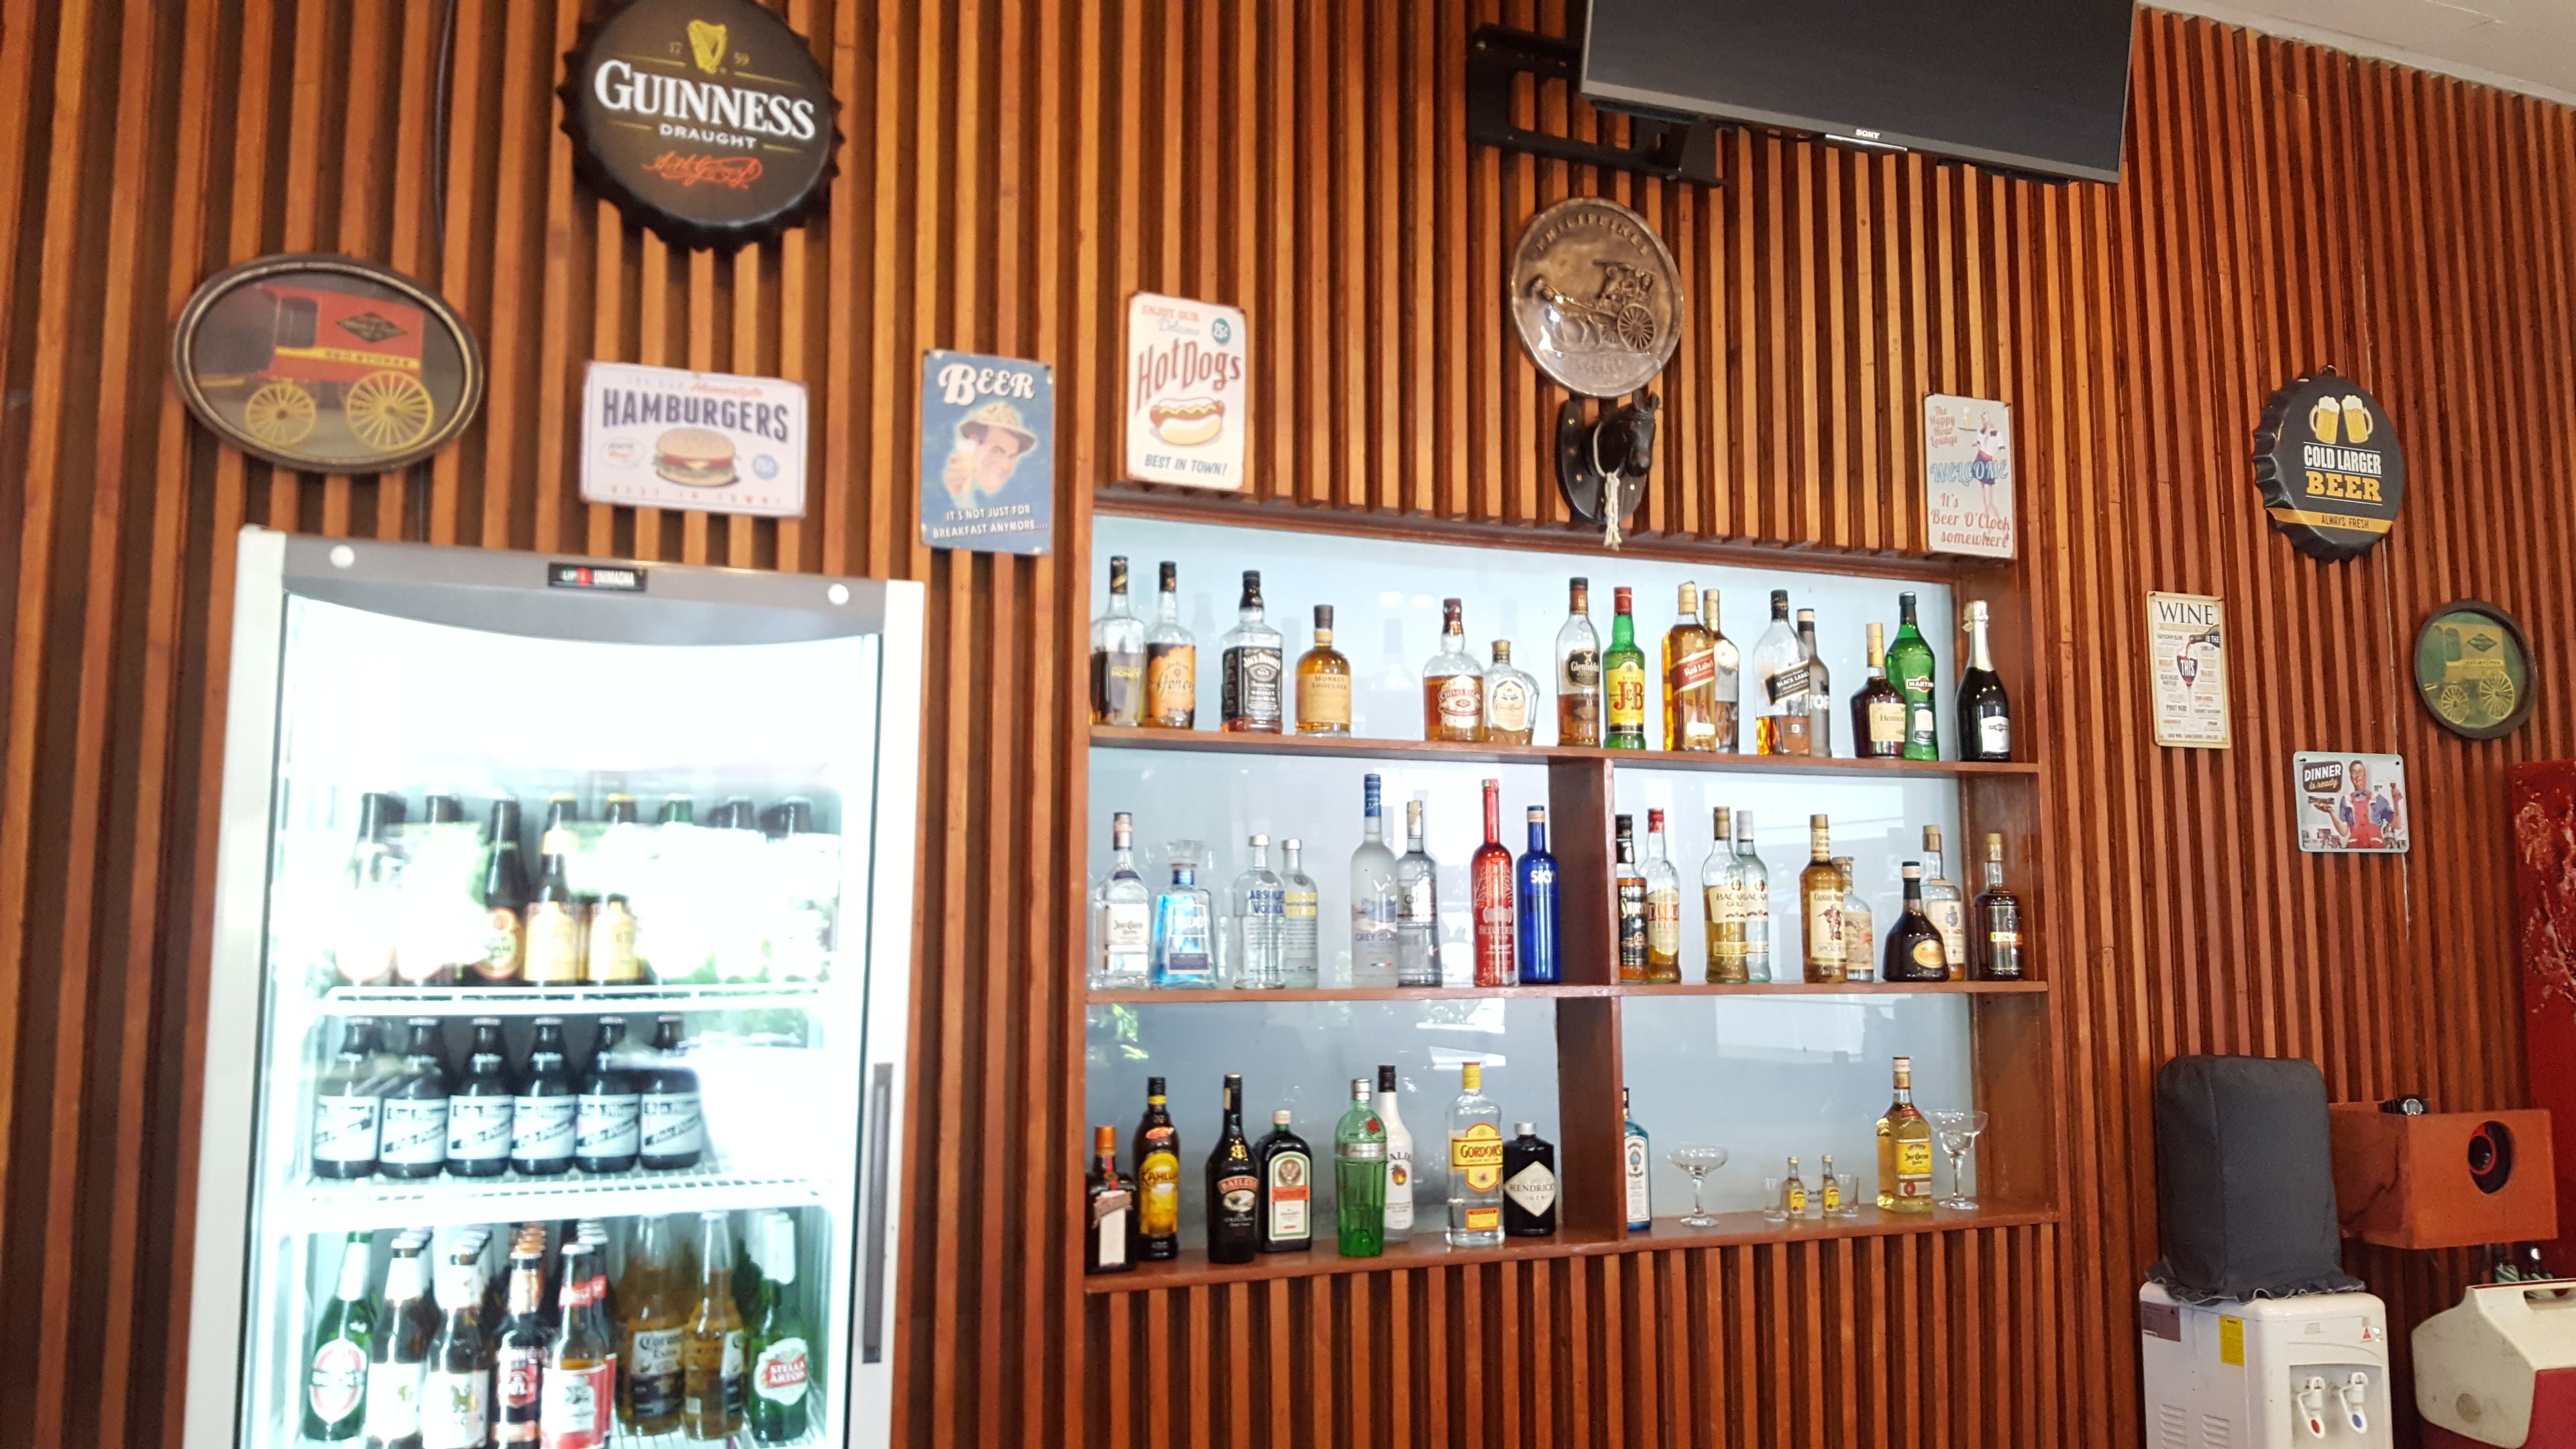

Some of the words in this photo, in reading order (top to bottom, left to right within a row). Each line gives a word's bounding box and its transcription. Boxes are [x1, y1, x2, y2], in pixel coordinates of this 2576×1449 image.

[594, 59, 816, 140] GUINNESS
[659, 122, 758, 150] DRAUGHT
[1856, 128, 1880, 139] SONY
[938, 362, 1036, 407] BEER
[602, 388, 790, 443] HAMBURGERS
[1935, 405, 1947, 415] The
[1929, 415, 1955, 428] Happy
[1934, 426, 1953, 436] Hour
[1929, 435, 1958, 449] Lounge
[1144, 453, 1172, 469] BEST
[1175, 458, 1188, 472] IN
[1191, 459, 1228, 476] TOWN!
[2304, 445, 2336, 469] COLD
[2338, 449, 2382, 475] LARGER
[1929, 460, 2009, 487] WELCOME
[2306, 470, 2383, 502] BEER
[1940, 492, 1958, 508] It's
[965, 508, 985, 520] NOT
[987, 506, 1009, 518] JUST
[1012, 504, 1030, 515] FOR
[1931, 508, 1960, 527] Beer
[2321, 513, 2346, 527] ALWAYS
[2349, 516, 2369, 529] FRESH
[932, 523, 987, 539] BREAKFAST
[1940, 531, 2010, 549] somewhere
[2157, 601, 2214, 625] WINE
[1684, 665, 1698, 677] Red
[2180, 659, 2196, 677] THIS
[1776, 677, 1794, 688] BLACK
[1439, 688, 1464, 699] CHIVAS
[2304, 763, 2341, 782] DINNER
[2316, 777, 2339, 789] ready
[1460, 1144, 1503, 1159] GORDON'S
[770, 1360, 806, 1374] STELLA
